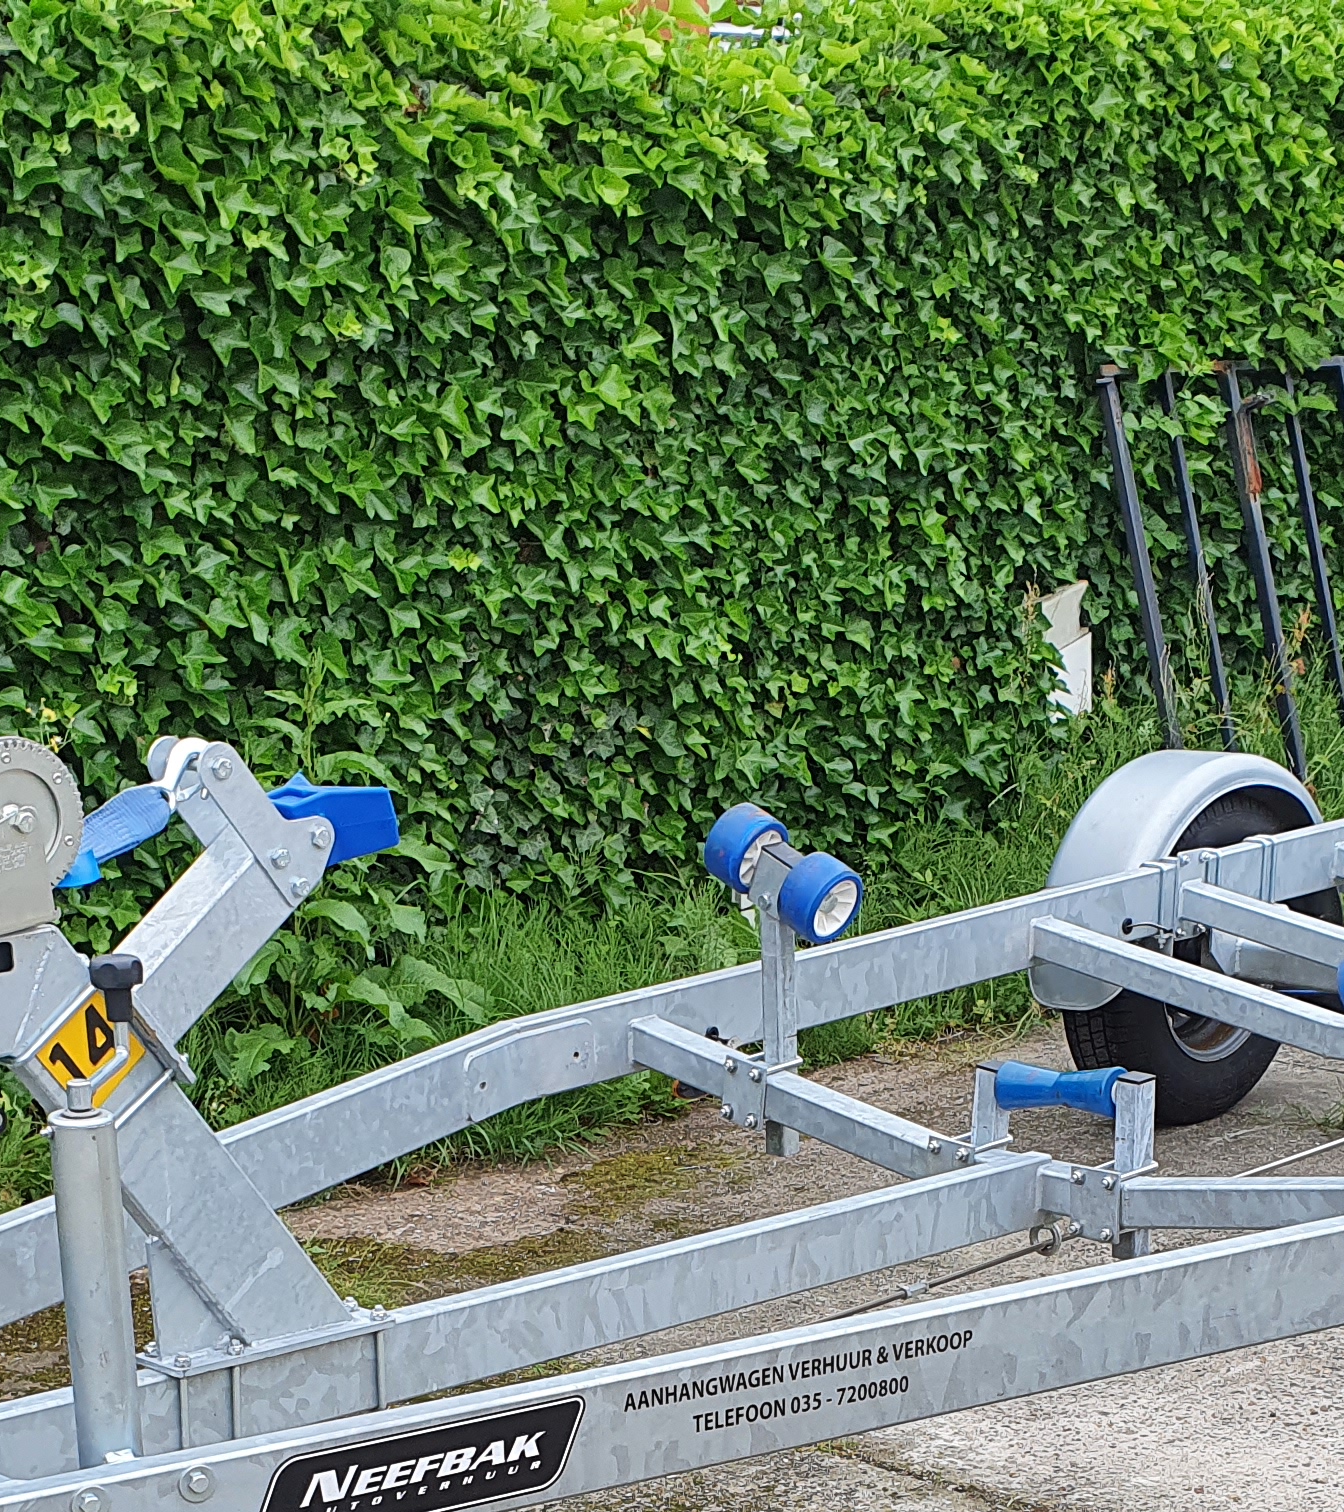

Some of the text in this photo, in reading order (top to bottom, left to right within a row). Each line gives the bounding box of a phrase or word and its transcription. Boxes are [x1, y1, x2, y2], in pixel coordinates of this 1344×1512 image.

[623, 1330, 973, 1413] AANHANGWAGEN VERHUUR & VERKOOP
[692, 1398, 786, 1433] TELEFOON
[790, 1392, 822, 1414] 035
[837, 1375, 909, 1406] 7200800
[299, 1431, 547, 1509] NEEFBAK
